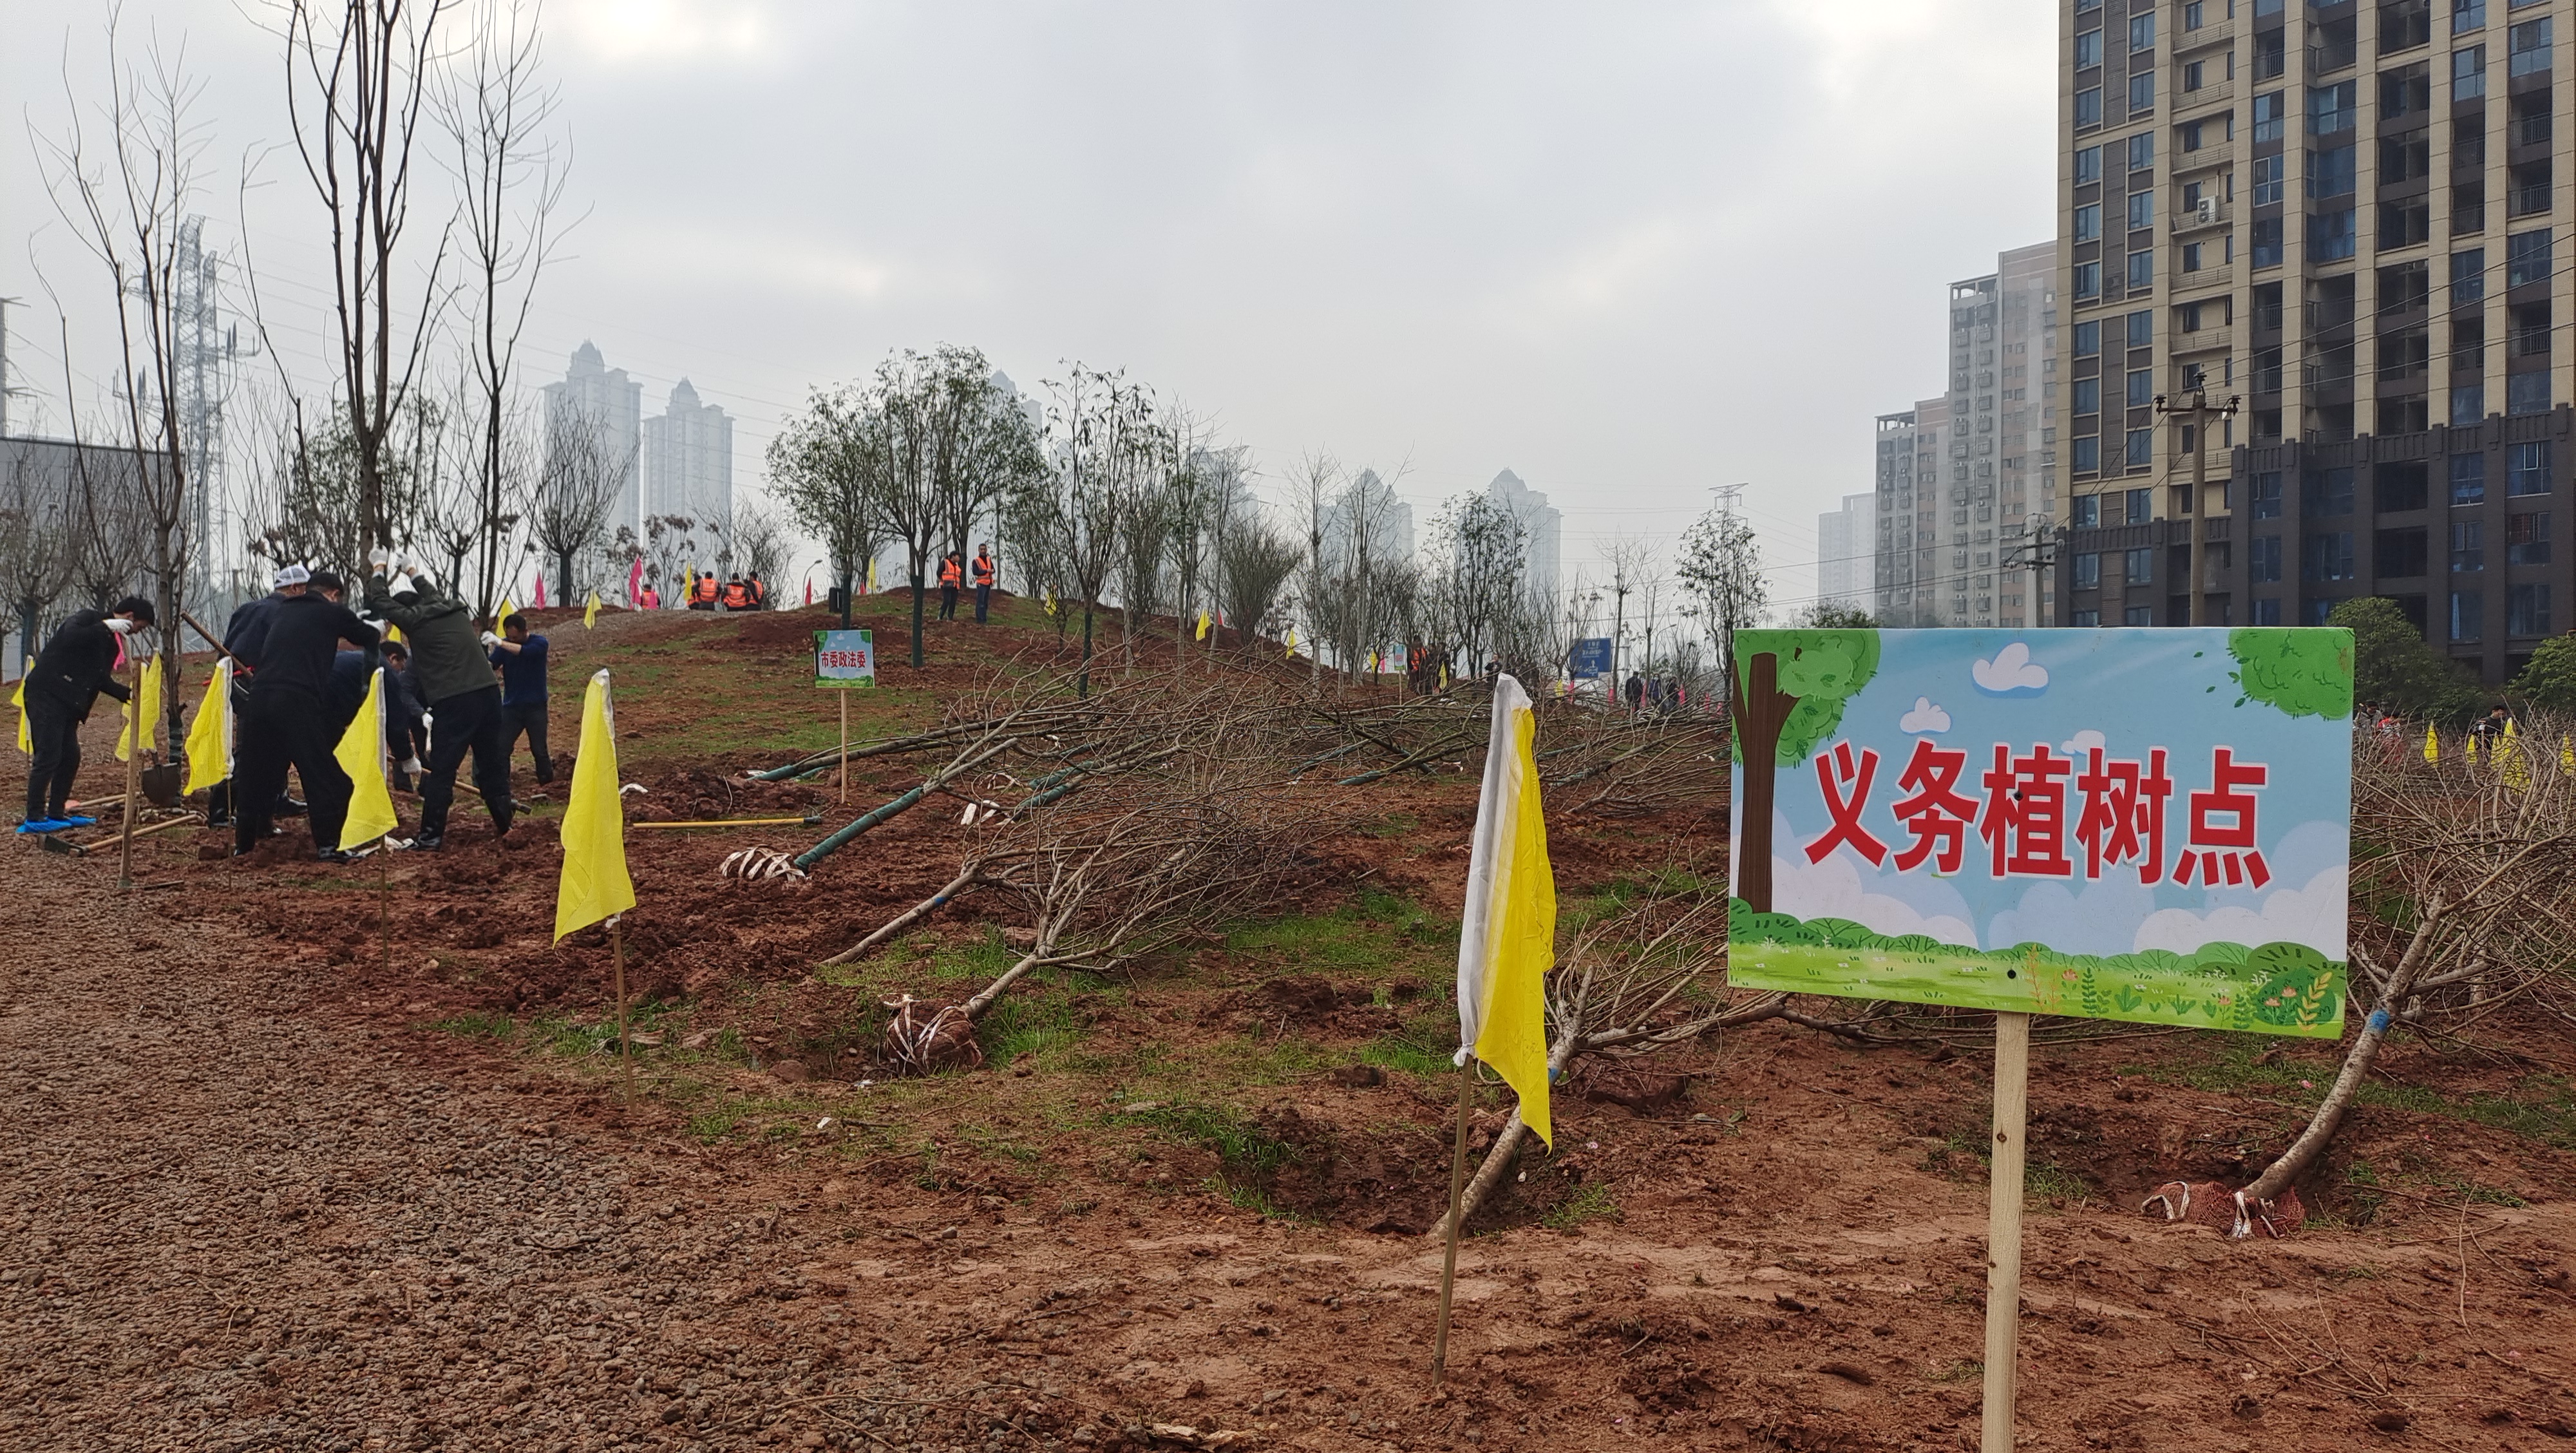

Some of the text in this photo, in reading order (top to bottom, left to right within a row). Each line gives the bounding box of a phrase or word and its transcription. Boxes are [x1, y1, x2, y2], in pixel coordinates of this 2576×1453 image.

[820, 651, 866, 668] 市委政法委
[1804, 739, 2271, 889] 义务植树点
